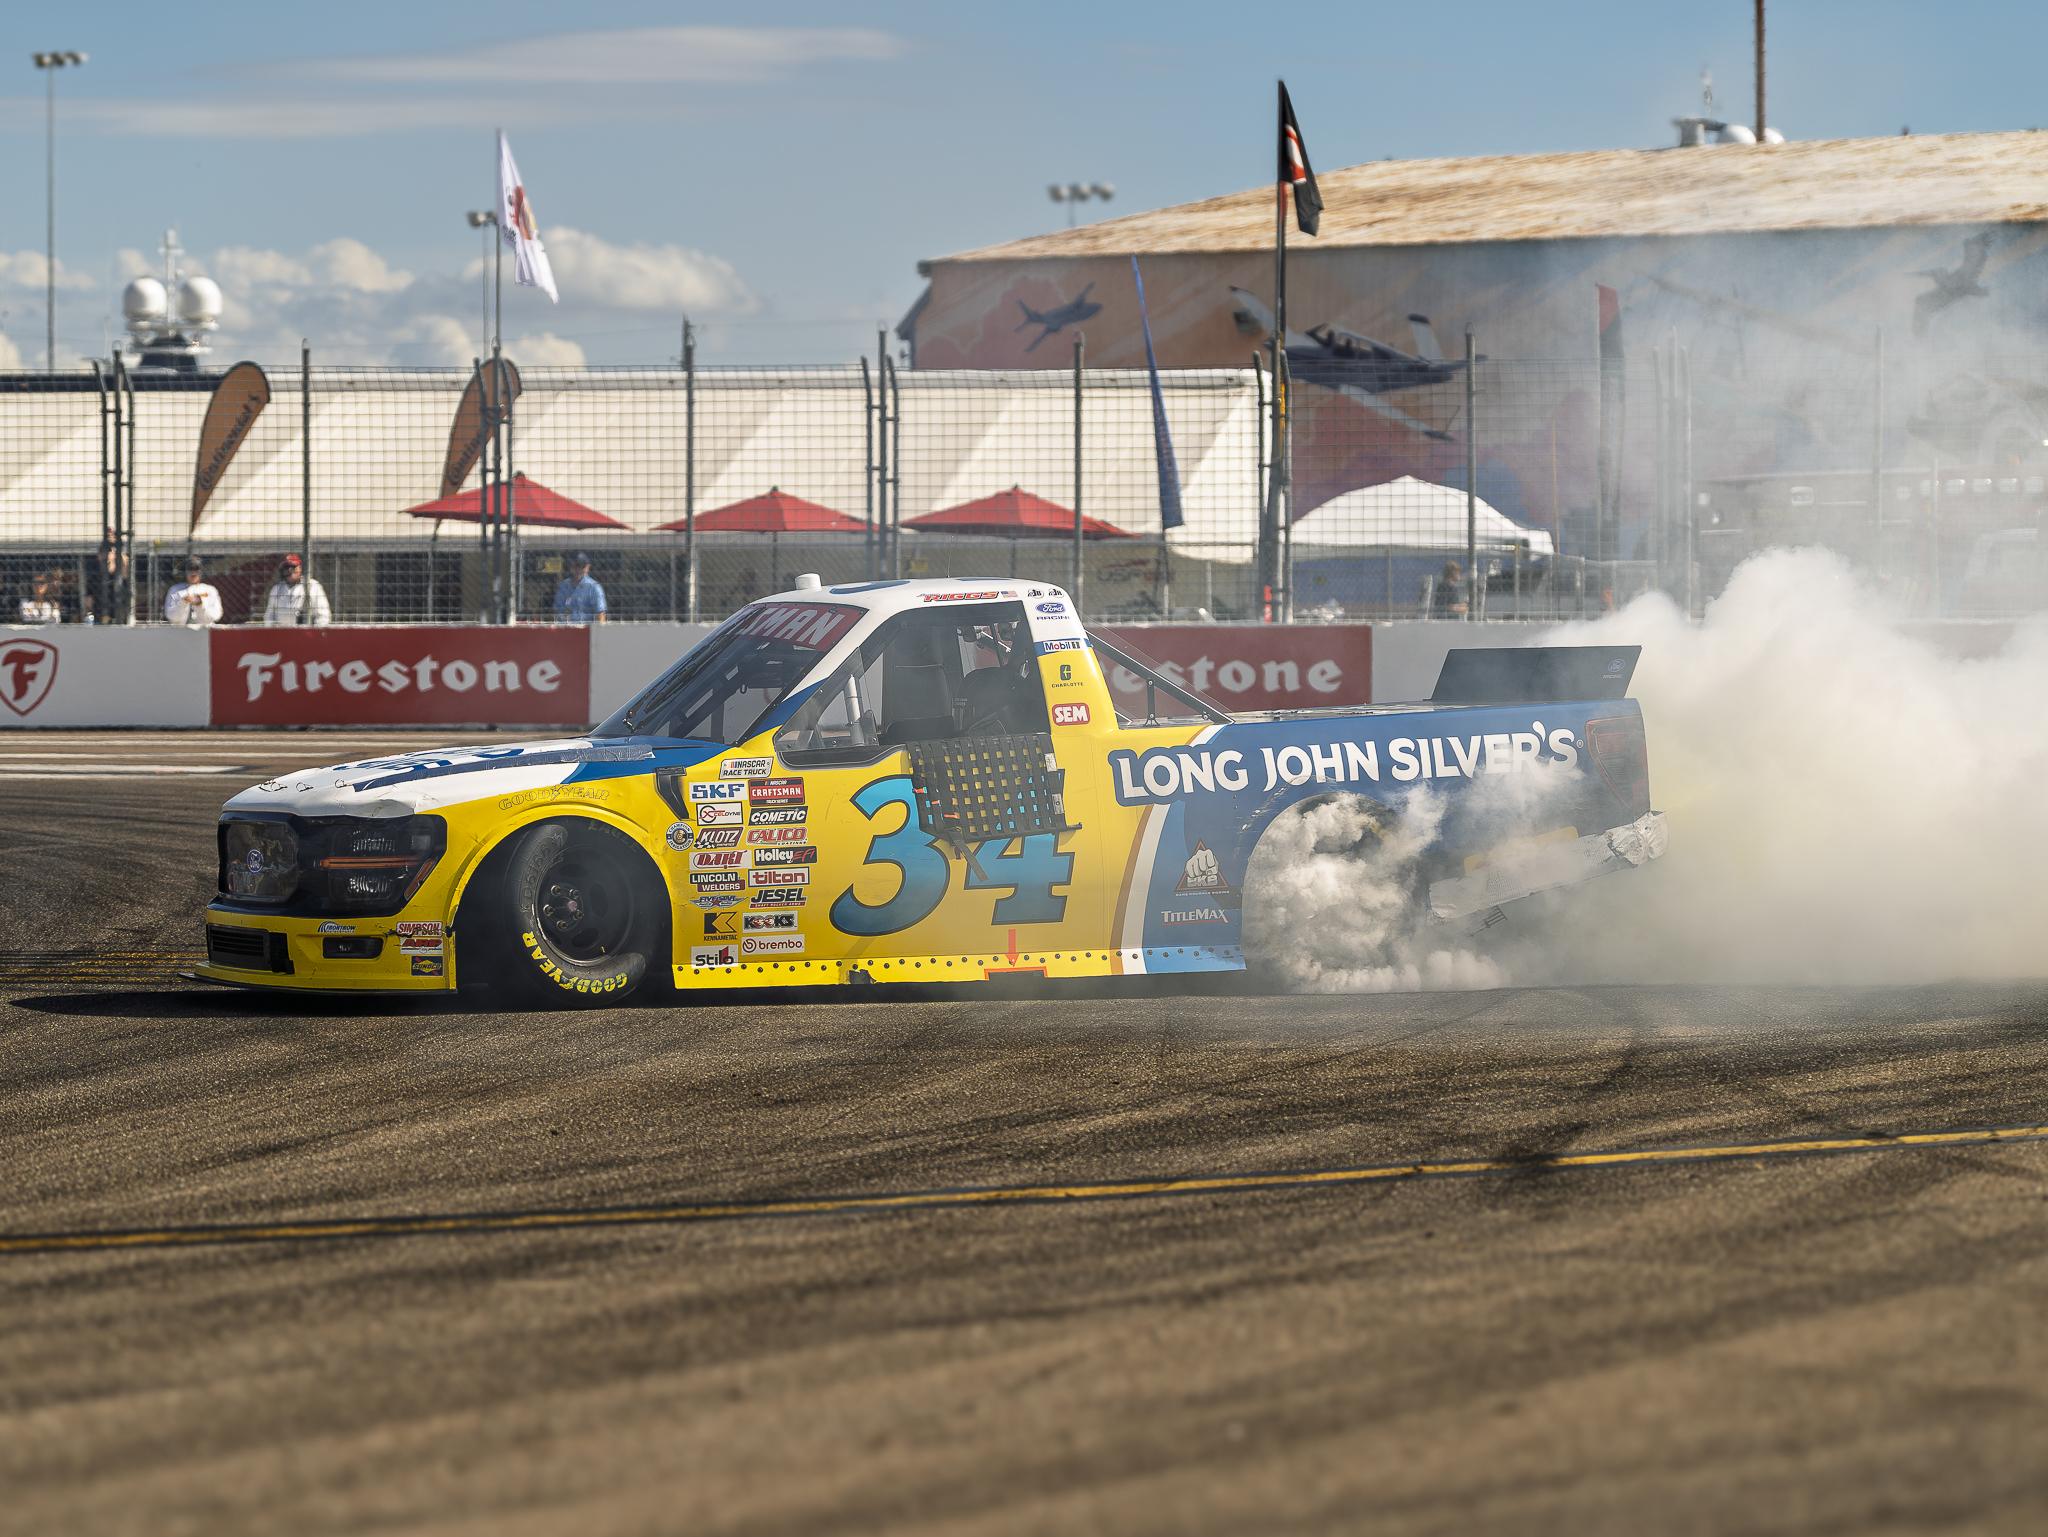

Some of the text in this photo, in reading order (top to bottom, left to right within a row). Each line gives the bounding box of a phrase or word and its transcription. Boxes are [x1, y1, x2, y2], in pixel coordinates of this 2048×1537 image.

[923, 591, 999, 603] RIGGS
[1044, 642, 1071, 651] Mobil
[237, 651, 562, 703] Firestone
[1054, 705, 1089, 724] SEM
[735, 758, 766, 768] NASCAR
[1116, 720, 1579, 799] LONG JOHN SILVER'S
[722, 768, 767, 777] RACE TRUCK
[499, 783, 611, 812] GOODYEAR
[692, 783, 745, 799] SKF
[751, 786, 802, 797] CRAFTSMAN
[750, 810, 807, 823] COMETIC
[700, 830, 740, 843] KLOTZ
[747, 828, 808, 844] CALICO
[697, 850, 748, 866] DART
[756, 849, 794, 864] Holley
[829, 768, 1077, 937] 34
[692, 873, 736, 884] LINCOLN
[752, 870, 806, 884] tilton
[702, 882, 740, 892] WELDERS
[751, 888, 806, 903] JESEL
[398, 922, 440, 936] SIMPSON
[704, 934, 738, 942] KENNAMETAL
[758, 939, 803, 950] brembo
[522, 930, 629, 995] GOODYEAR
[696, 946, 735, 967] Stilo
